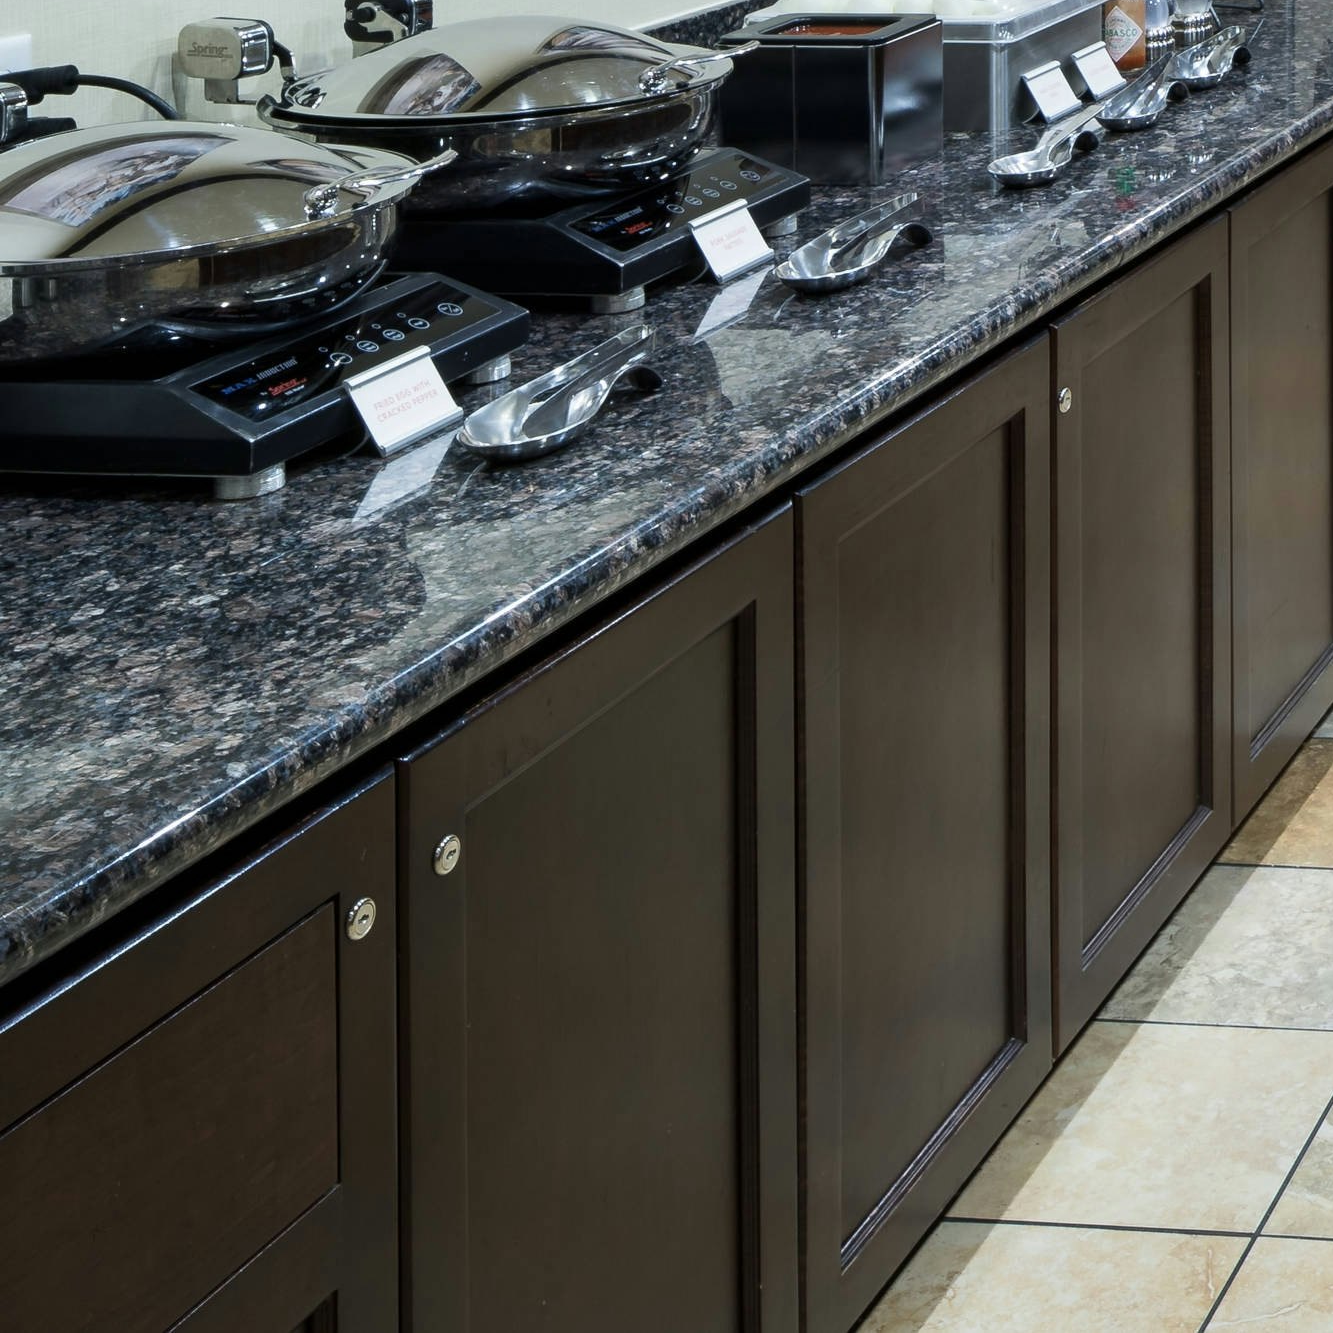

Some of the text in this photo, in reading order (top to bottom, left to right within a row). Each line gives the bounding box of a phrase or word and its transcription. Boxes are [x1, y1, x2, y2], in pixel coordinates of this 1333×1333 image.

[1104, 28, 1138, 38] ABASCO
[187, 42, 229, 59] Spring
[373, 377, 432, 412] FRIED EGG WITH
[376, 388, 439, 423] CRACKED PEPPER
